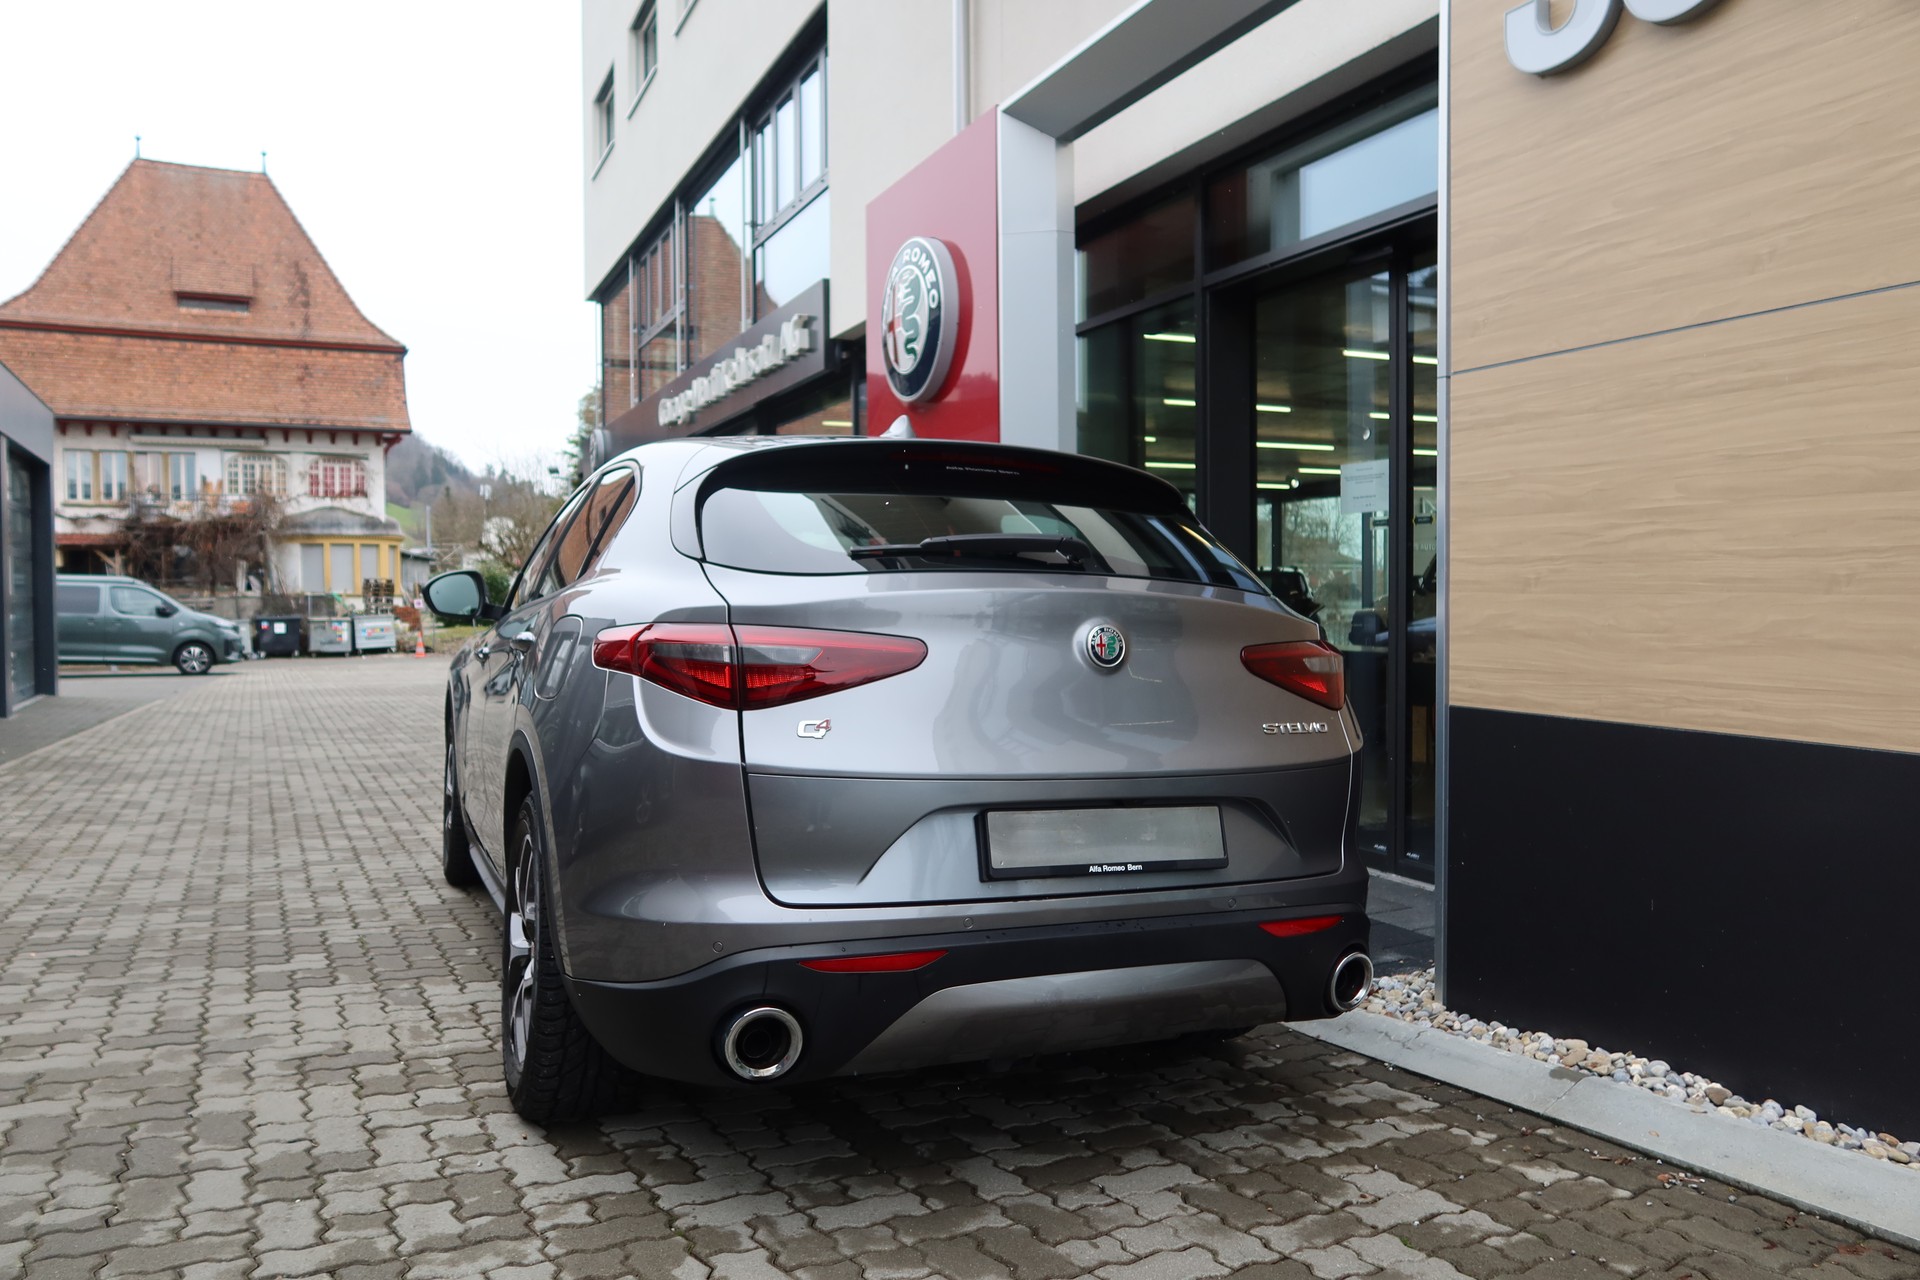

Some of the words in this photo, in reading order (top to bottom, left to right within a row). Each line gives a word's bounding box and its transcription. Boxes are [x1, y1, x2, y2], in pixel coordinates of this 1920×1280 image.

[902, 247, 939, 308] ROMEO
[1091, 629, 1102, 646] ALFA
[1104, 627, 1123, 647] ROMEO
[1262, 722, 1328, 734] STELVIO
[1088, 865, 1102, 873] Alfa
[1103, 864, 1125, 872] Romeo
[1127, 863, 1143, 871] Bern
